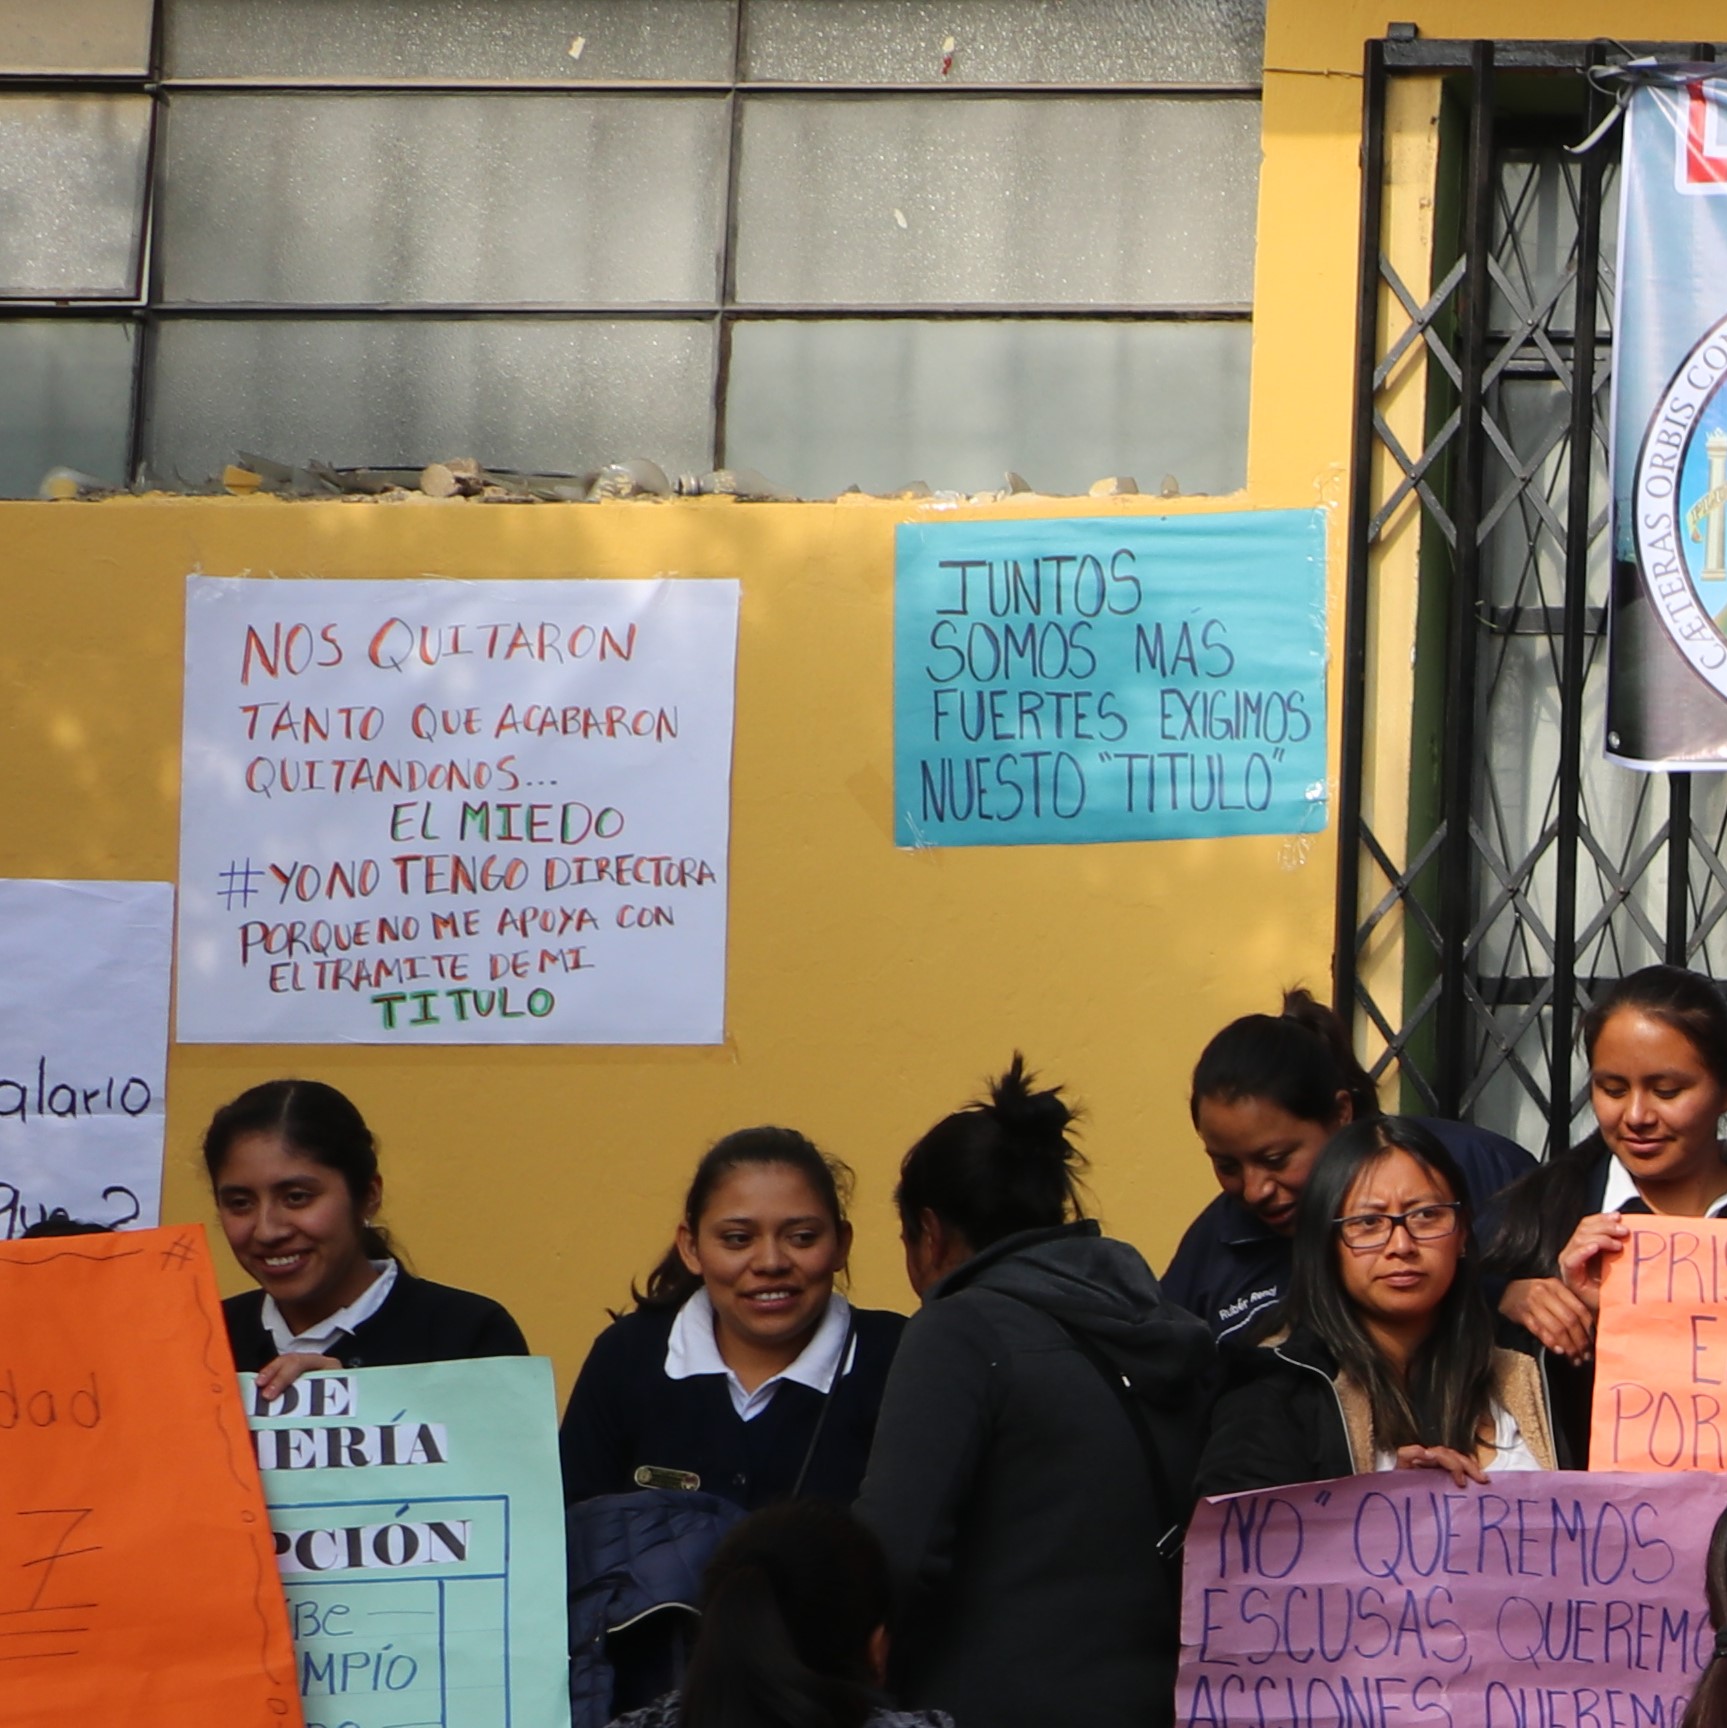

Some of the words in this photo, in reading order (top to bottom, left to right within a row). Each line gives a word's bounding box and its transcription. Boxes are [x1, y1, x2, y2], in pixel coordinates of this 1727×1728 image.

[1645, 396, 1695, 499] ORBIS
[240, 621, 343, 686] NOS
[368, 616, 637, 672] QUITARON
[926, 620, 1097, 682] SOMOS
[239, 702, 384, 742] TANTO
[411, 703, 483, 741] QUE
[493, 704, 679, 742] ACABARON
[933, 688, 1128, 742] FUERTES
[1159, 687, 1312, 742] EXIGIMOS
[920, 751, 1087, 822] NUESTO
[390, 802, 438, 843] EL
[459, 800, 625, 843] MIEDO
[392, 855, 528, 896] TENGO
[545, 855, 716, 889] DIRECTORA
[431, 909, 483, 938] ME
[496, 907, 600, 938] APOYA
[617, 903, 675, 929] CON
[371, 986, 556, 1029] TITULO
[1607, 1382, 1724, 1470] POR
[1354, 1491, 1675, 1587] QUEREMOS
